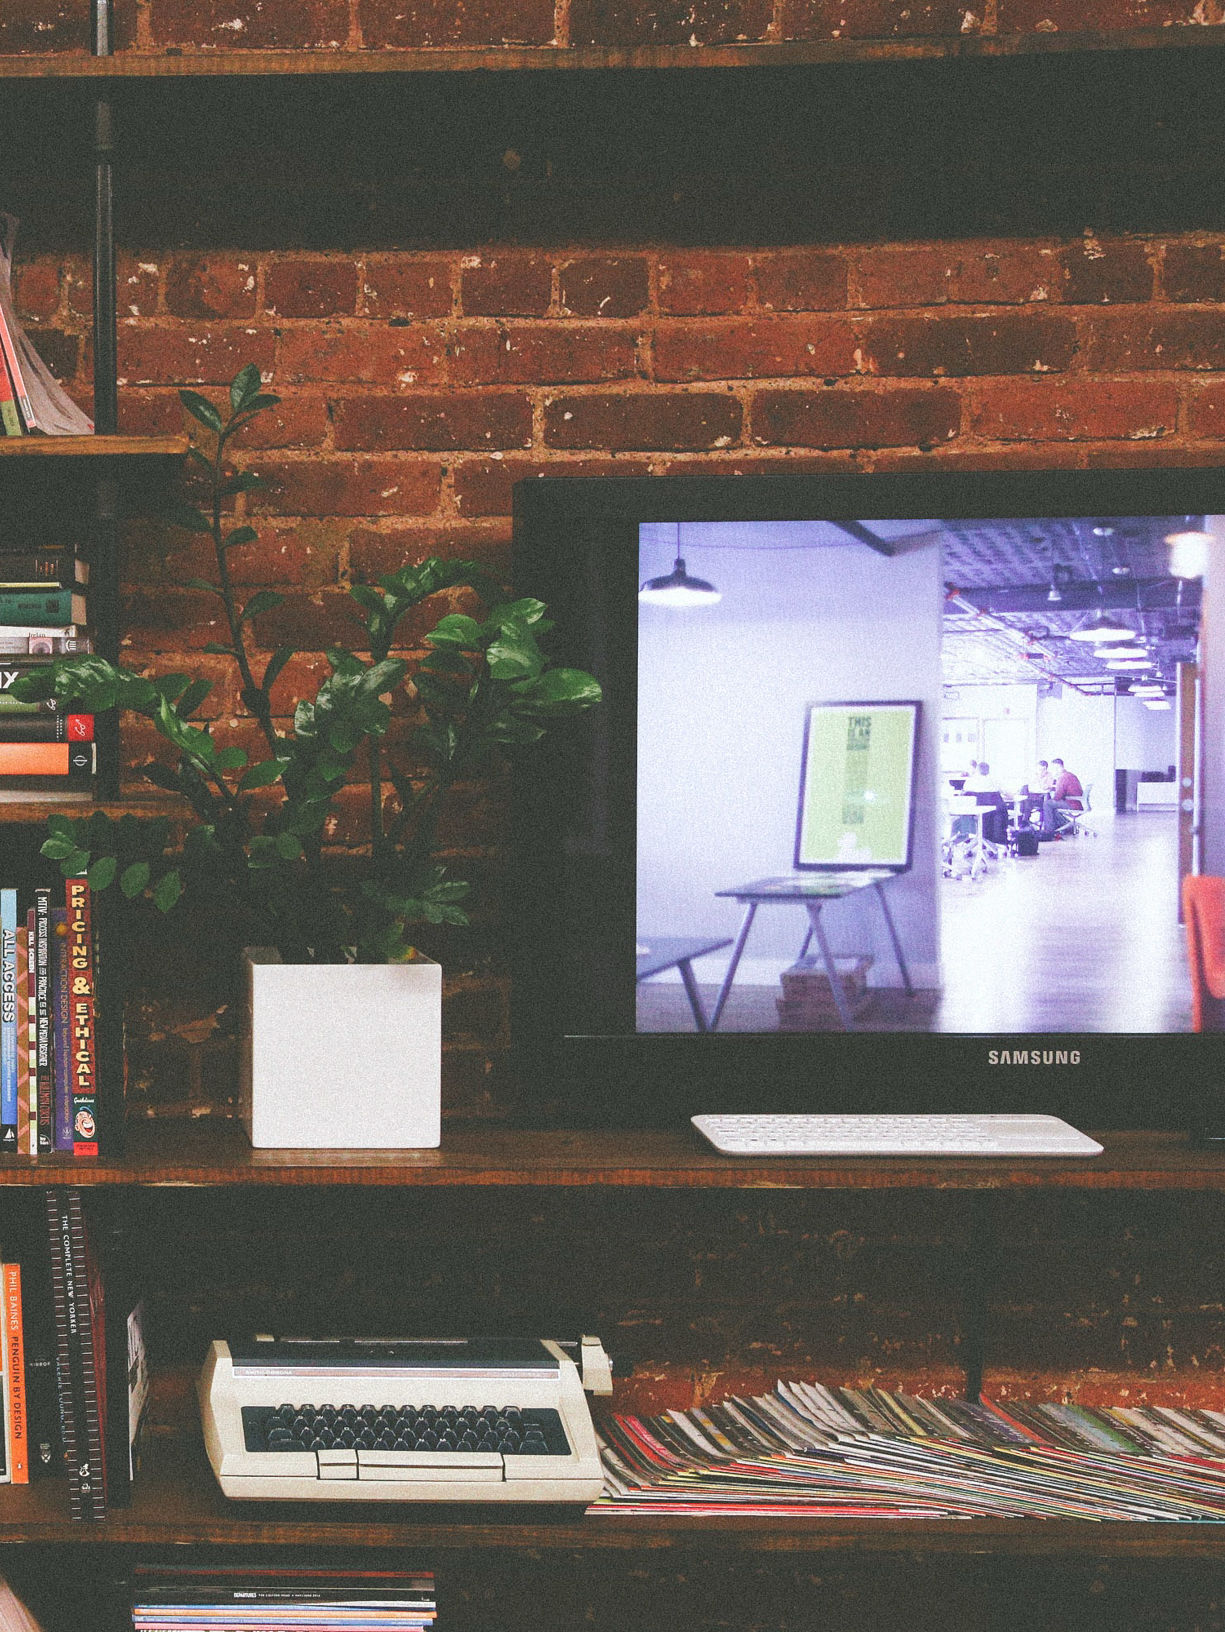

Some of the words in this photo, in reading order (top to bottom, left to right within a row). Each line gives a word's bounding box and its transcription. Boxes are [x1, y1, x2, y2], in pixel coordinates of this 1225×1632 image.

[3, 930, 15, 958] ALL
[72, 885, 88, 969] PRICING
[2, 961, 15, 1022] ACCESS
[73, 977, 92, 995] &
[75, 1003, 90, 1086] ETHICAL
[988, 1050, 1080, 1064] SAMSUNG
[64, 1235, 72, 1277] COMPLETE
[9, 1271, 17, 1292] PHIL
[10, 1296, 18, 1330] BAINES
[12, 1336, 20, 1384] PENGUIN
[13, 1387, 20, 1399] BY
[14, 1402, 22, 1439] DESIGN
